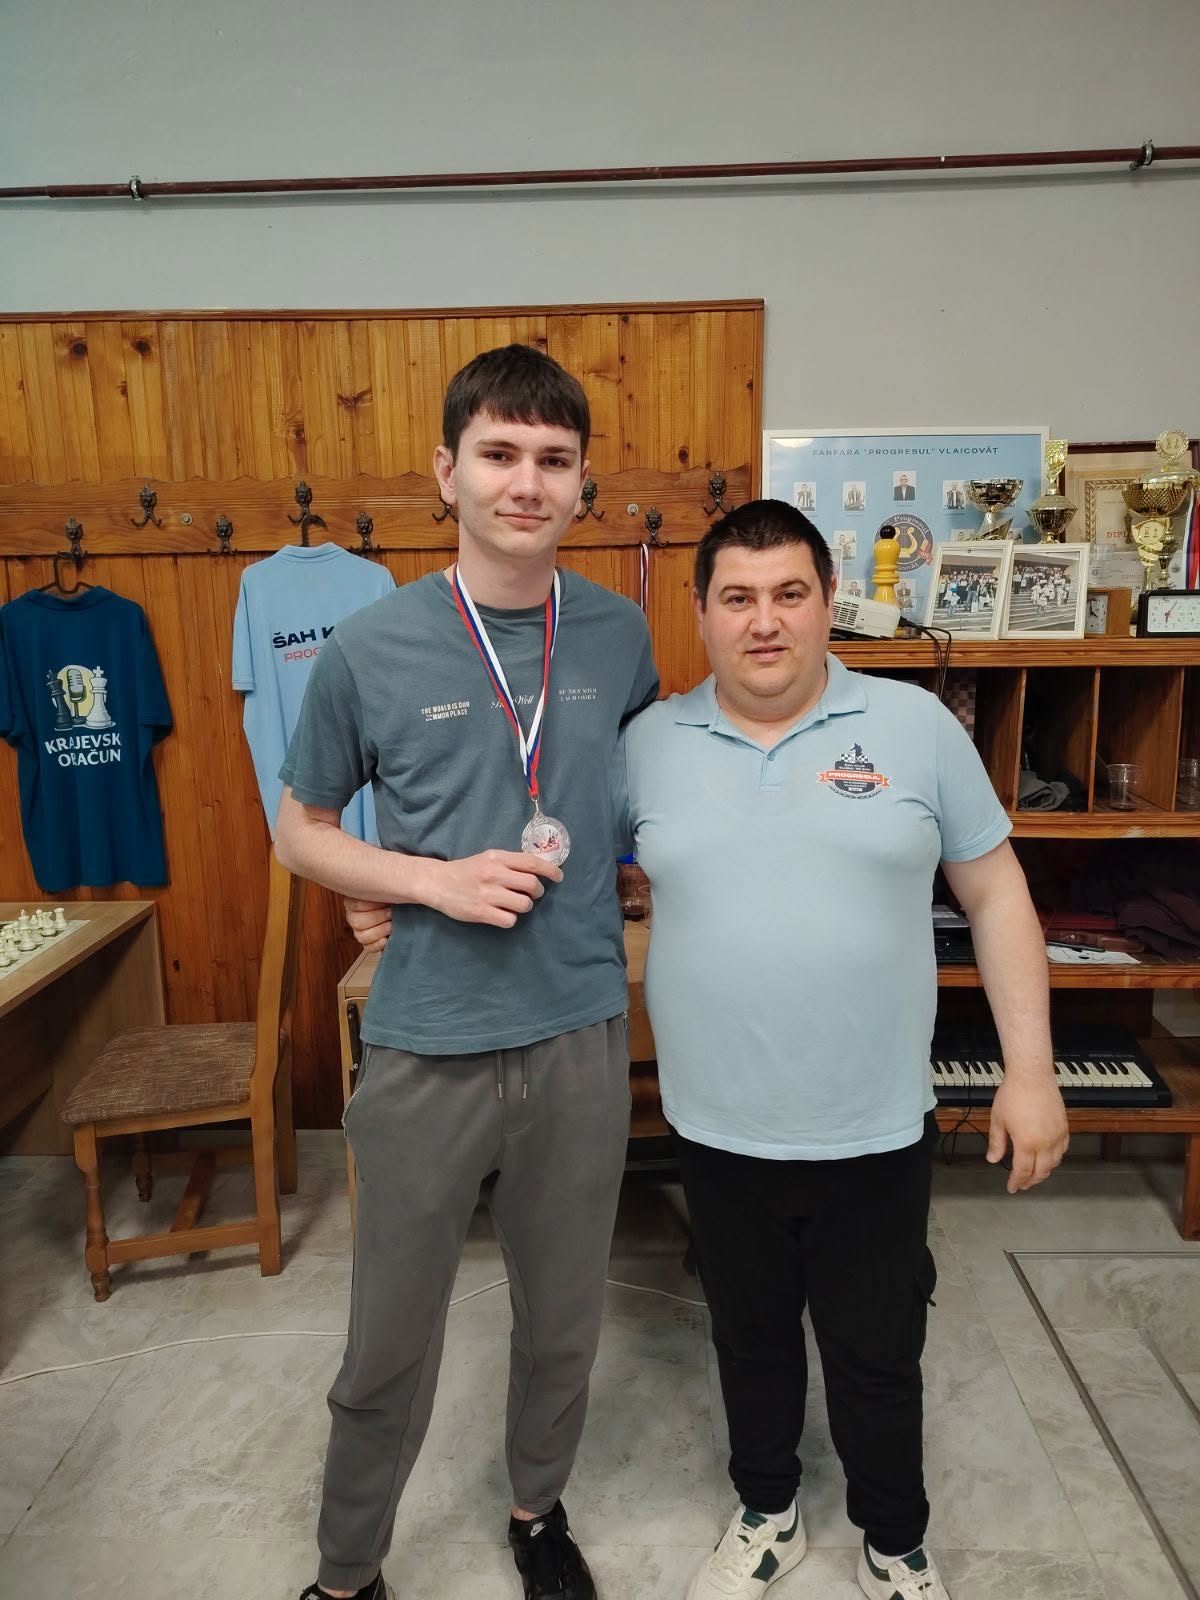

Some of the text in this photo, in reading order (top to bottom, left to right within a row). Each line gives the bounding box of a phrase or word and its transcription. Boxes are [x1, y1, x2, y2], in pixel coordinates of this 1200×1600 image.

[863, 447, 936, 456] "PROGRESUL"
[272, 626, 334, 649] ŠAH K
[452, 702, 458, 710] IS
[449, 708, 468, 718] PLACE
[828, 772, 881, 780] PROGRESUL
